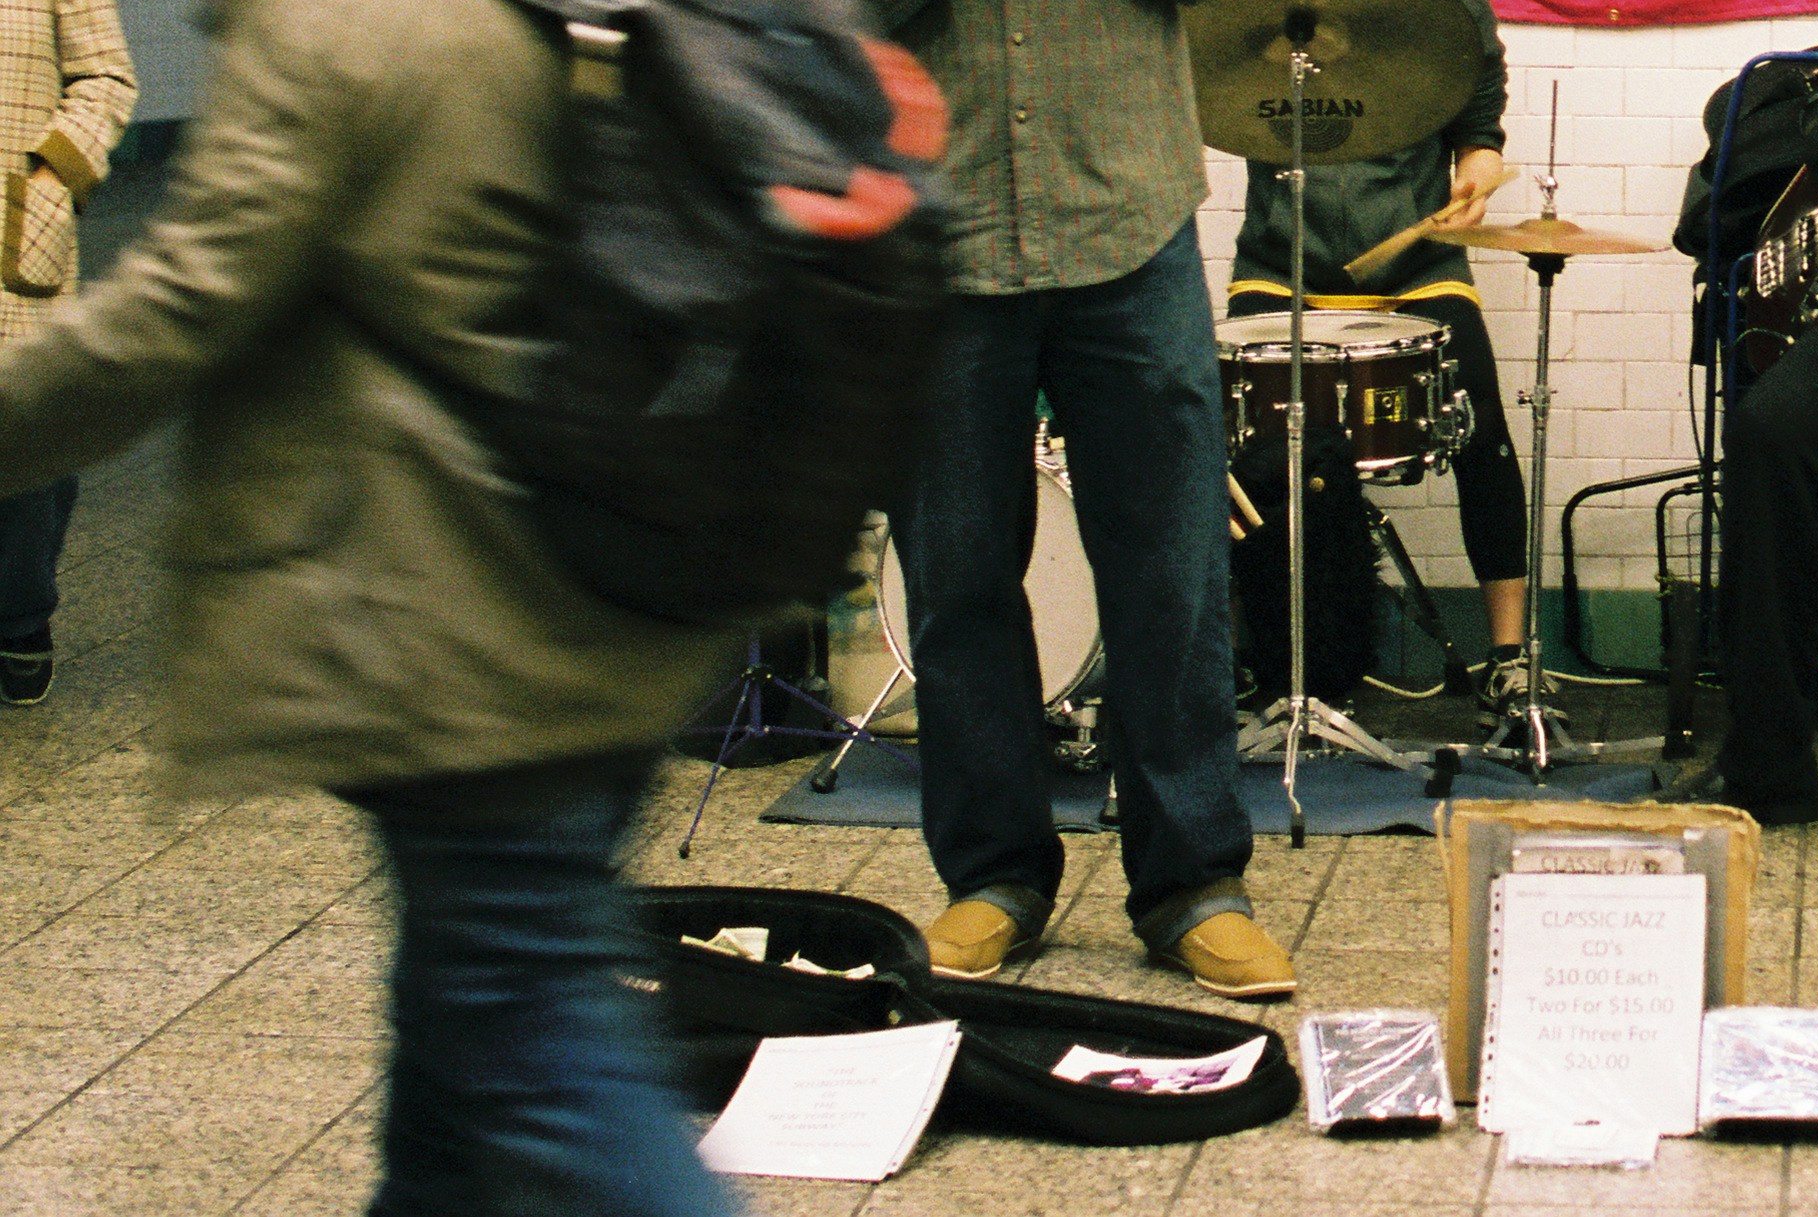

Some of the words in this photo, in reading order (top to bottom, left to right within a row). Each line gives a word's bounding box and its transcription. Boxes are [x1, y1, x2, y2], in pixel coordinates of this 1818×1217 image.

[1257, 98, 1364, 120] SABIAN
[1541, 910, 1618, 929] CLASSIC
[1622, 911, 1666, 929] JAZZ
[1581, 940, 1622, 958] CD's
[1614, 969, 1659, 986] Each
[1527, 996, 1567, 1013] Two
[1573, 997, 1602, 1014] For
[1537, 1025, 1562, 1041] All
[1568, 1025, 1622, 1042] Three
[1628, 1025, 1659, 1042] For
